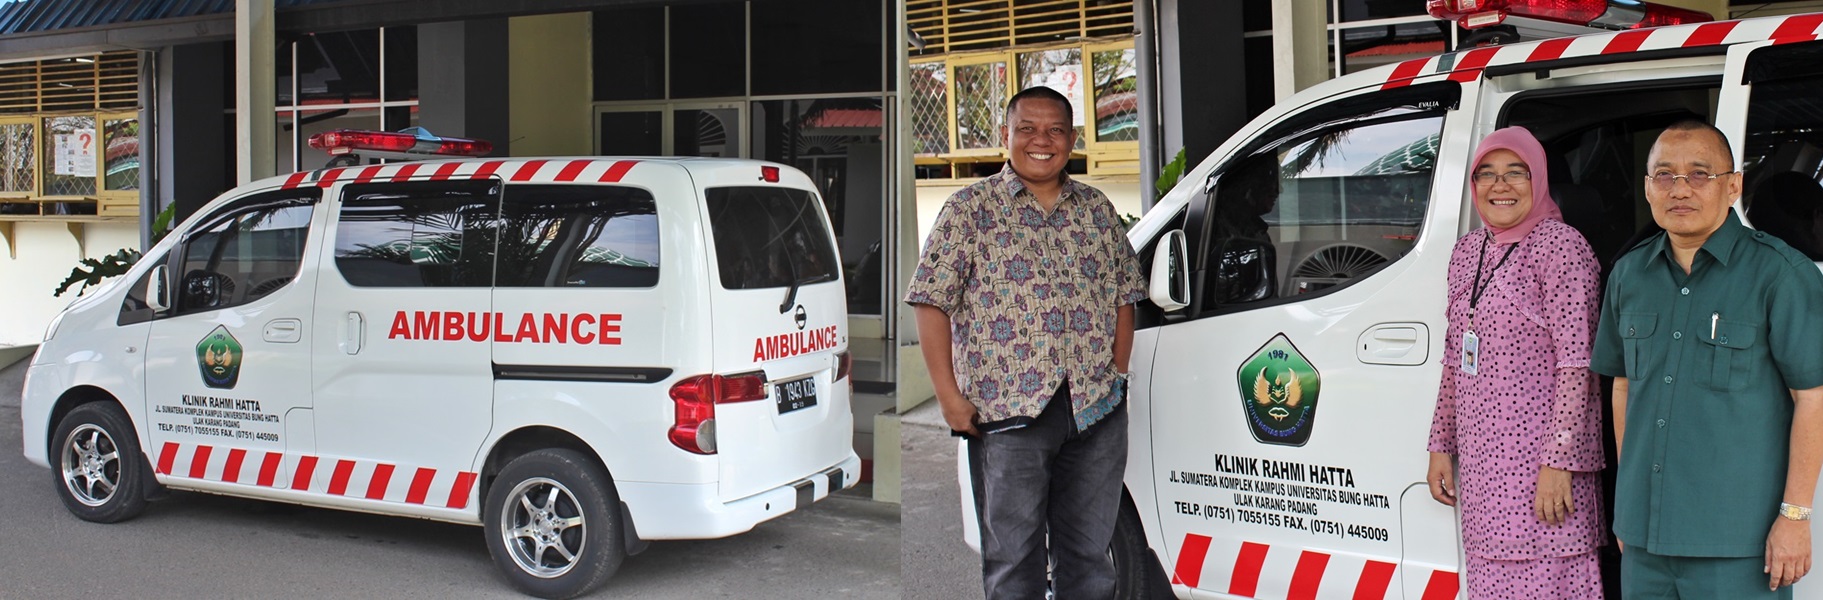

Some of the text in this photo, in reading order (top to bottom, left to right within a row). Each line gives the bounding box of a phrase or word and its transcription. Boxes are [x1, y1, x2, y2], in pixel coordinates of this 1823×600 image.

[388, 311, 623, 345] AMBULANCE
[753, 325, 837, 362] AMBULANCE
[1268, 349, 1289, 362] 1981
[775, 378, 816, 404] B 1943 KZG
[162, 406, 184, 414] SUMATERA
[184, 408, 204, 416] KOMPLEK
[204, 409, 222, 418] KAMPUS
[223, 410, 250, 420] UNIVERSITAS
[252, 413, 264, 421] BUNG
[265, 414, 279, 423] HATTA
[182, 395, 260, 412] KLINIK RAHMI HATTA
[158, 423, 278, 442] TELP. (0751) 7055155 FAX. (0751) 445009
[204, 418, 222, 427] KARANG
[223, 420, 240, 428] PADANG
[1214, 454, 1355, 488] KLINIK RAHMI HATTA
[1170, 470, 1390, 510] JL. SUMATERA KOMPLEK KAMPUS UNIVERSITAS BUNG HATTA
[1234, 493, 1318, 516] ULAK KARANG PADANG
[1174, 502, 1388, 542] TELP. (0751) 7055155 FAX. (0751) 445009
